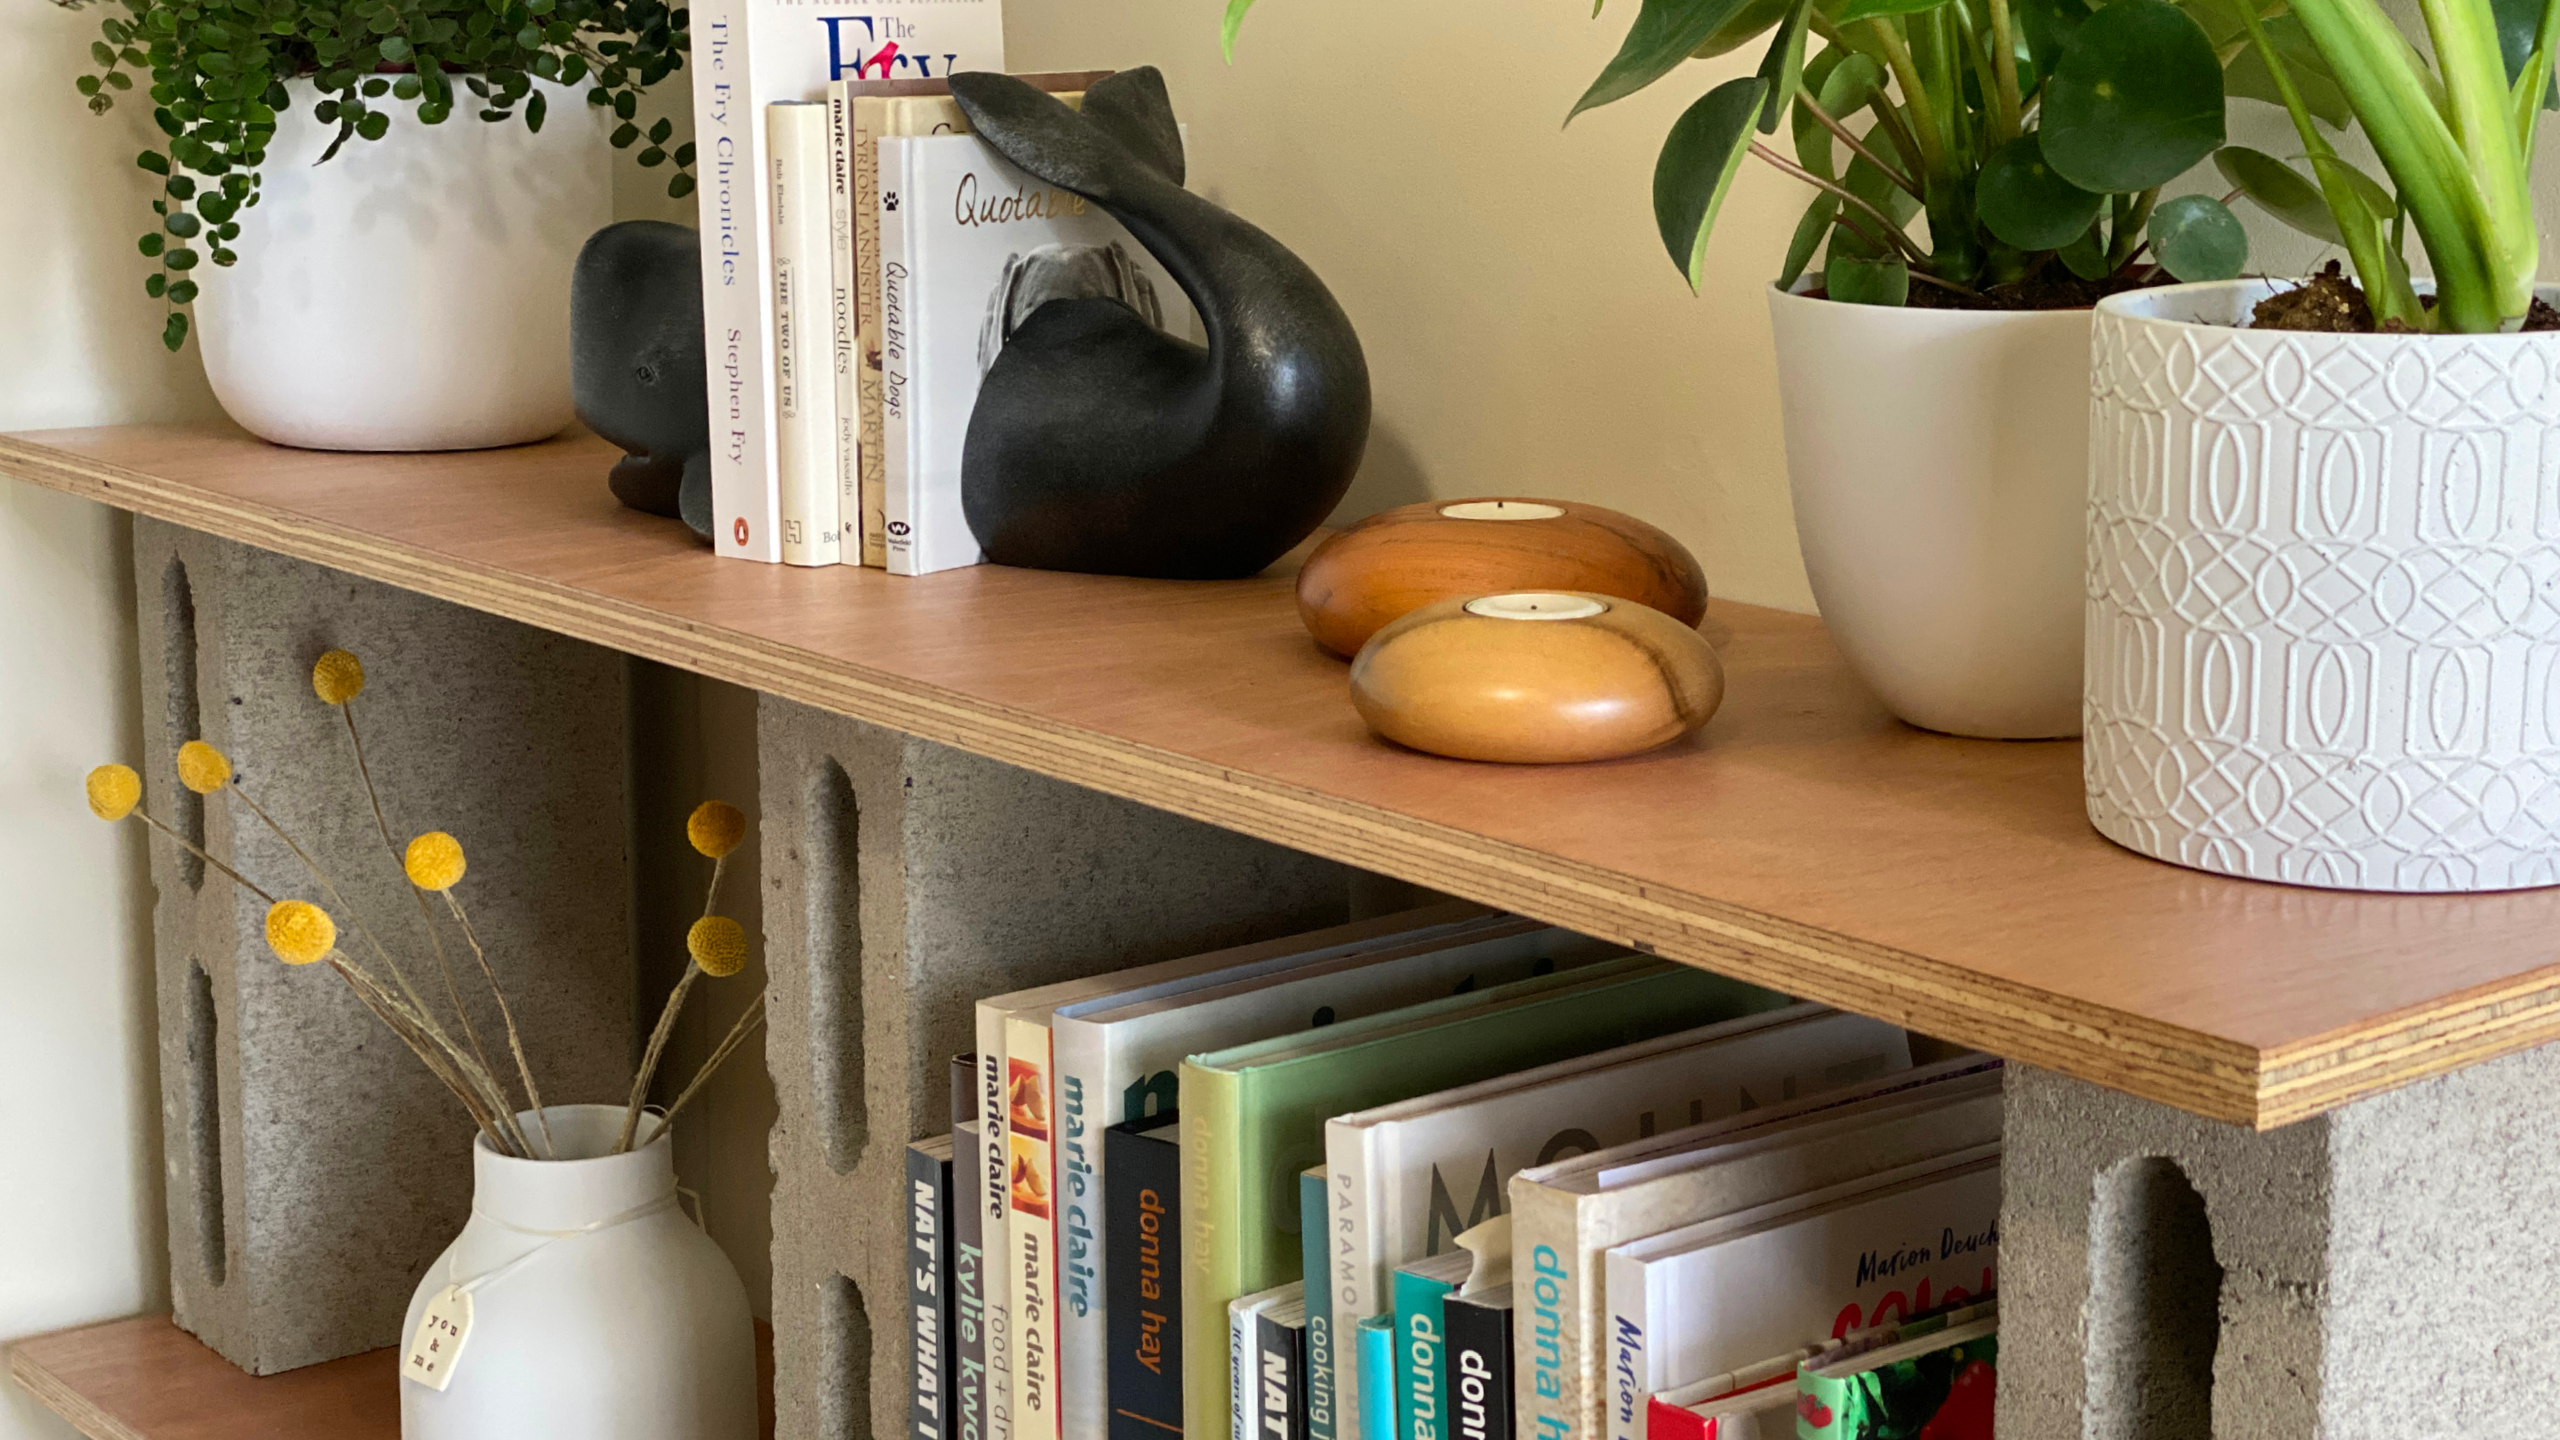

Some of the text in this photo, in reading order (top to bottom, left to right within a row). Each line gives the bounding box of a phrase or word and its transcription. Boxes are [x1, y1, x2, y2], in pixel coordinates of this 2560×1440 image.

[880, 17, 916, 39] The
[710, 15, 739, 286] The Fry Chronicles
[832, 99, 850, 251] marie claire style
[856, 124, 873, 325] TYRION LANNISTER
[779, 270, 792, 407] THE TWO OF US
[836, 287, 851, 374] noodles
[883, 261, 908, 419] Quotable Dogs
[724, 328, 745, 465] Stephen Fry
[841, 416, 852, 443] jody
[862, 378, 880, 480] MARTIN
[986, 1054, 1006, 1220] marie claire
[915, 1179, 936, 1297] NAT'S
[1064, 1074, 1095, 1319] marie claire
[1191, 1114, 1216, 1275] donna hay
[958, 1241, 984, 1343] kylie
[1136, 1187, 1167, 1375] donna hay
[1856, 1242, 1931, 1288] Marion
[413, 1354, 435, 1372] me
[428, 1314, 458, 1337] you
[430, 1337, 440, 1353] &
[916, 1304, 938, 1420] WHAT
[992, 1303, 1010, 1374] food
[1024, 1231, 1045, 1411] marie claire
[1231, 1327, 1242, 1353] 100
[1310, 1315, 1335, 1425] cooking
[1533, 1244, 1568, 1400] donna
[1615, 1314, 1642, 1424] Marion
[994, 1380, 1006, 1397] +
[1231, 1356, 1242, 1400] years
[1232, 1402, 1244, 1425] of
[1263, 1349, 1289, 1440] NAT
[1410, 1313, 1442, 1440] donna
